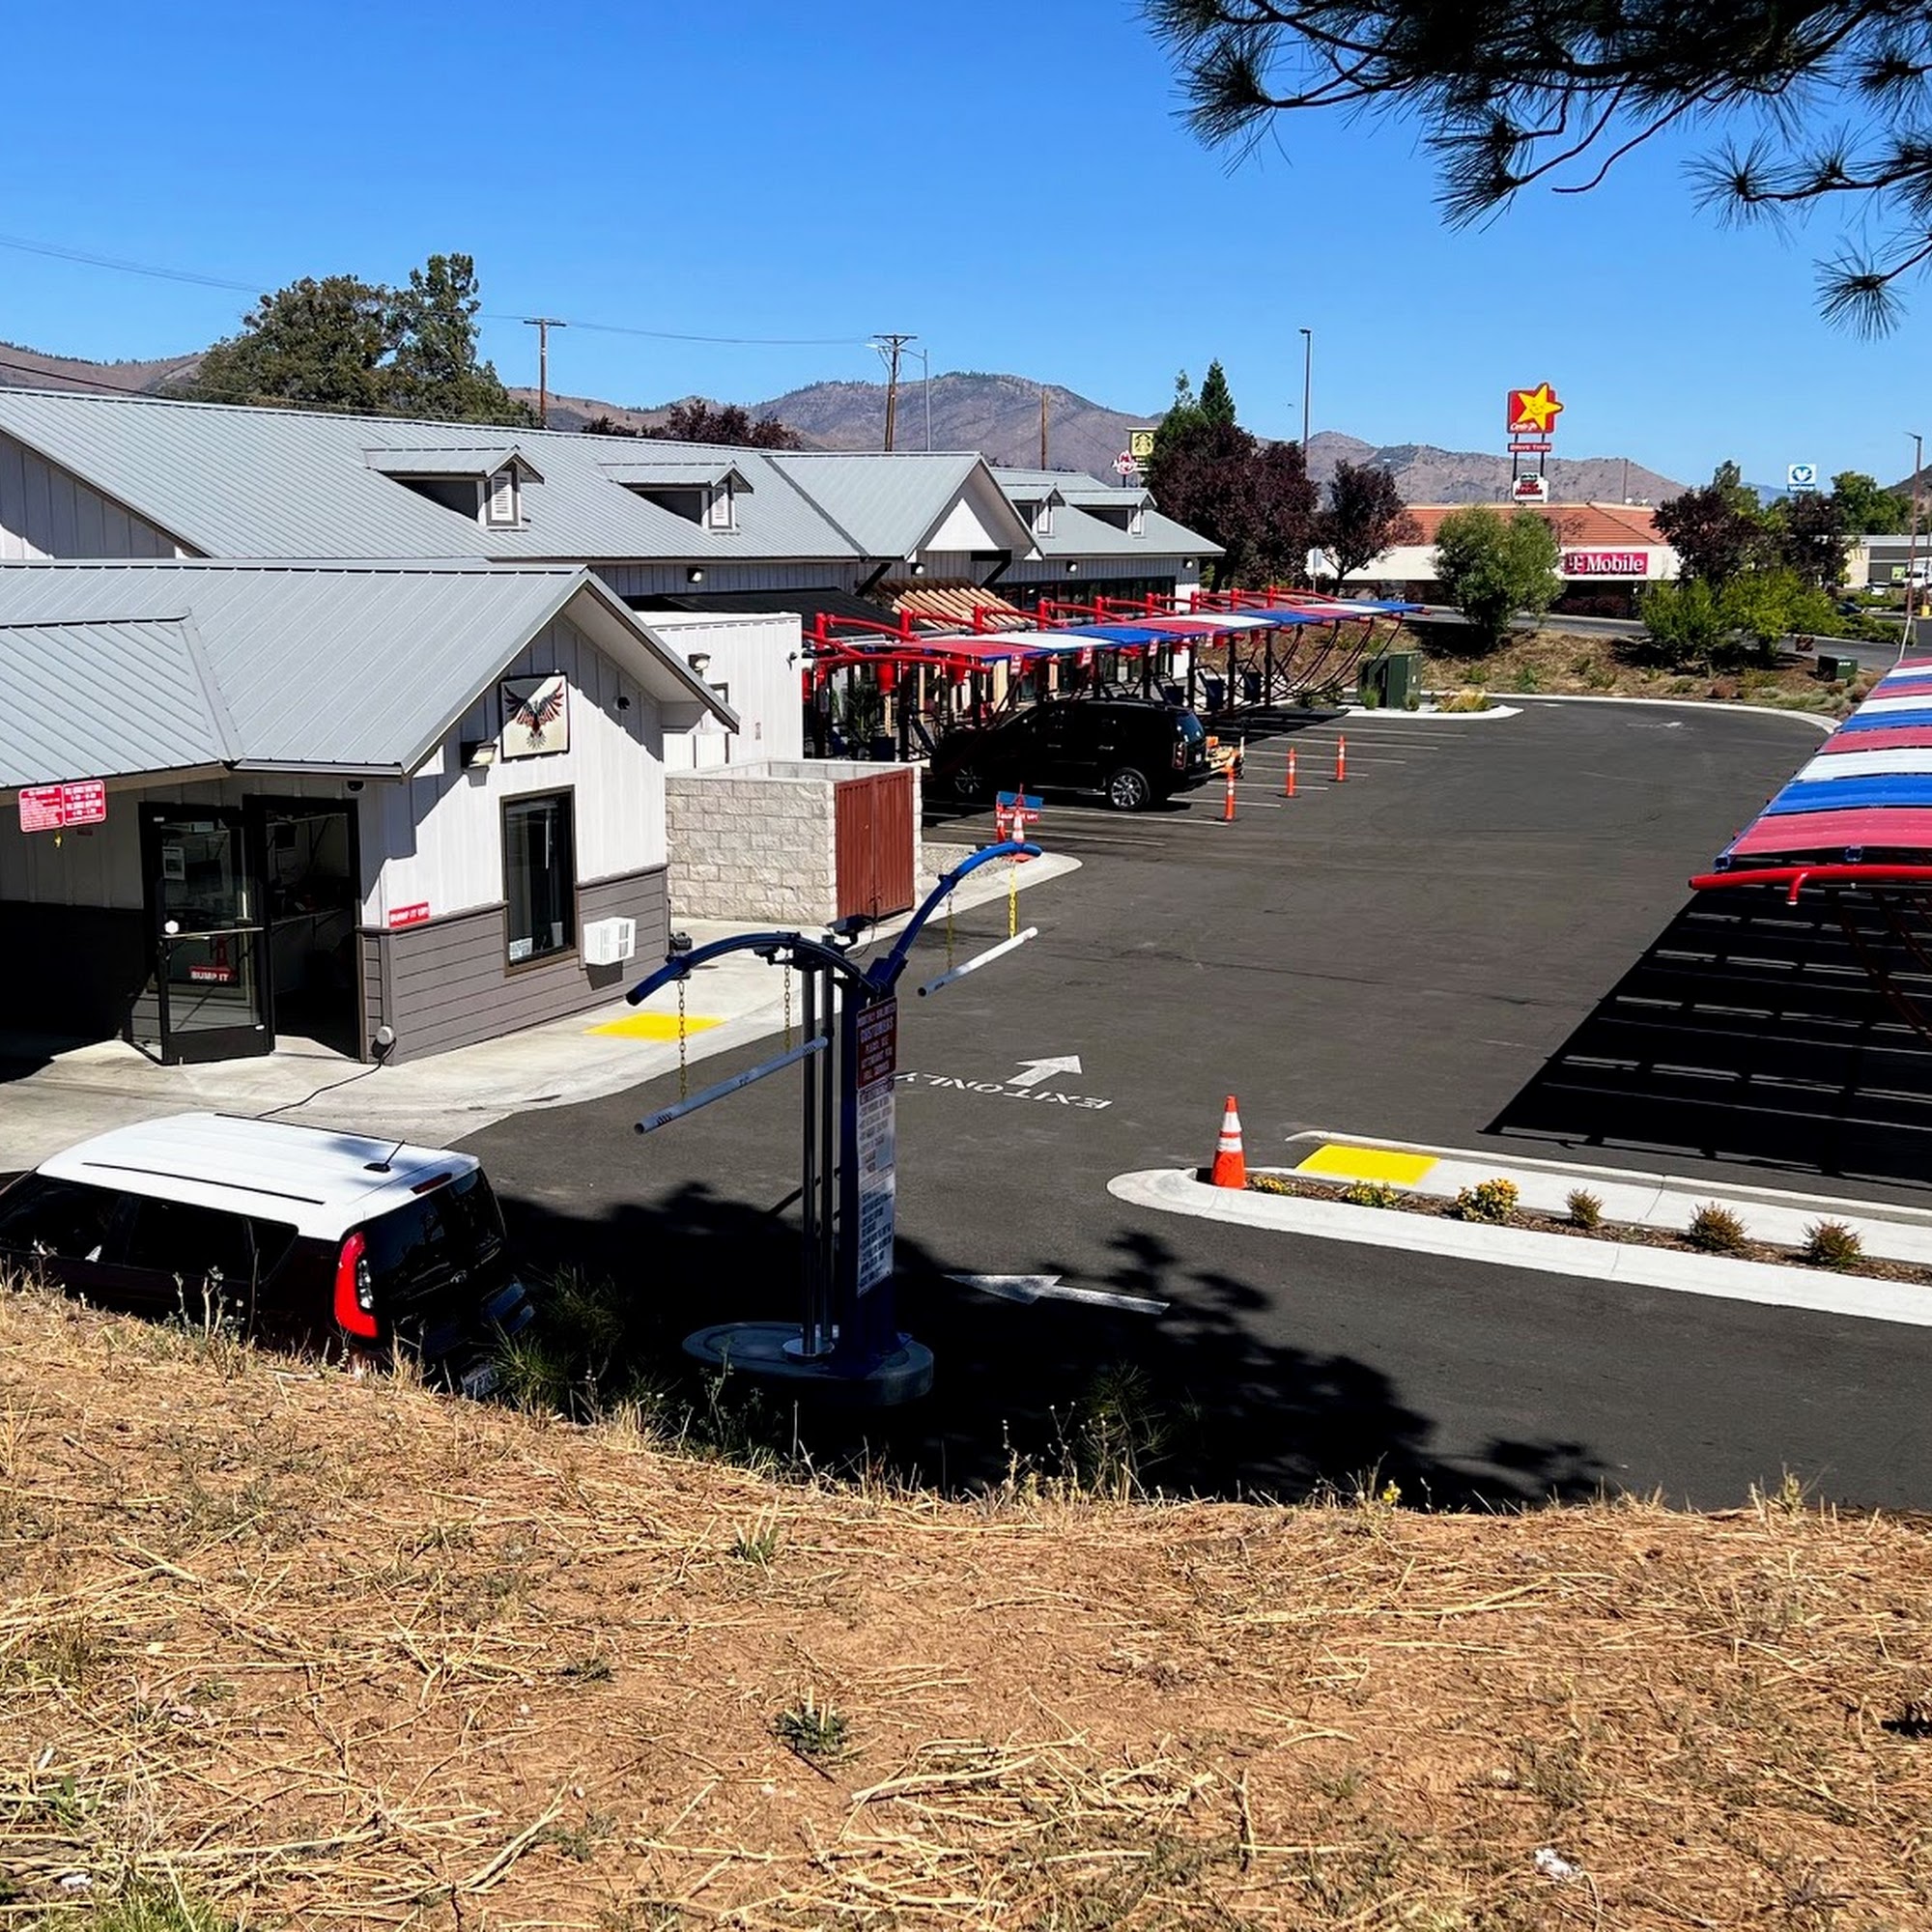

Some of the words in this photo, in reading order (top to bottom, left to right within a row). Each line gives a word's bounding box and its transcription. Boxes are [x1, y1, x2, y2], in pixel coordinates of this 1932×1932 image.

[1586, 554, 1645, 572] Mobile
[191, 971, 217, 980] BUMP
[219, 973, 229, 981] IT
[894, 1071, 1004, 1094] ONLY
[1003, 1088, 1113, 1110] EXIT
